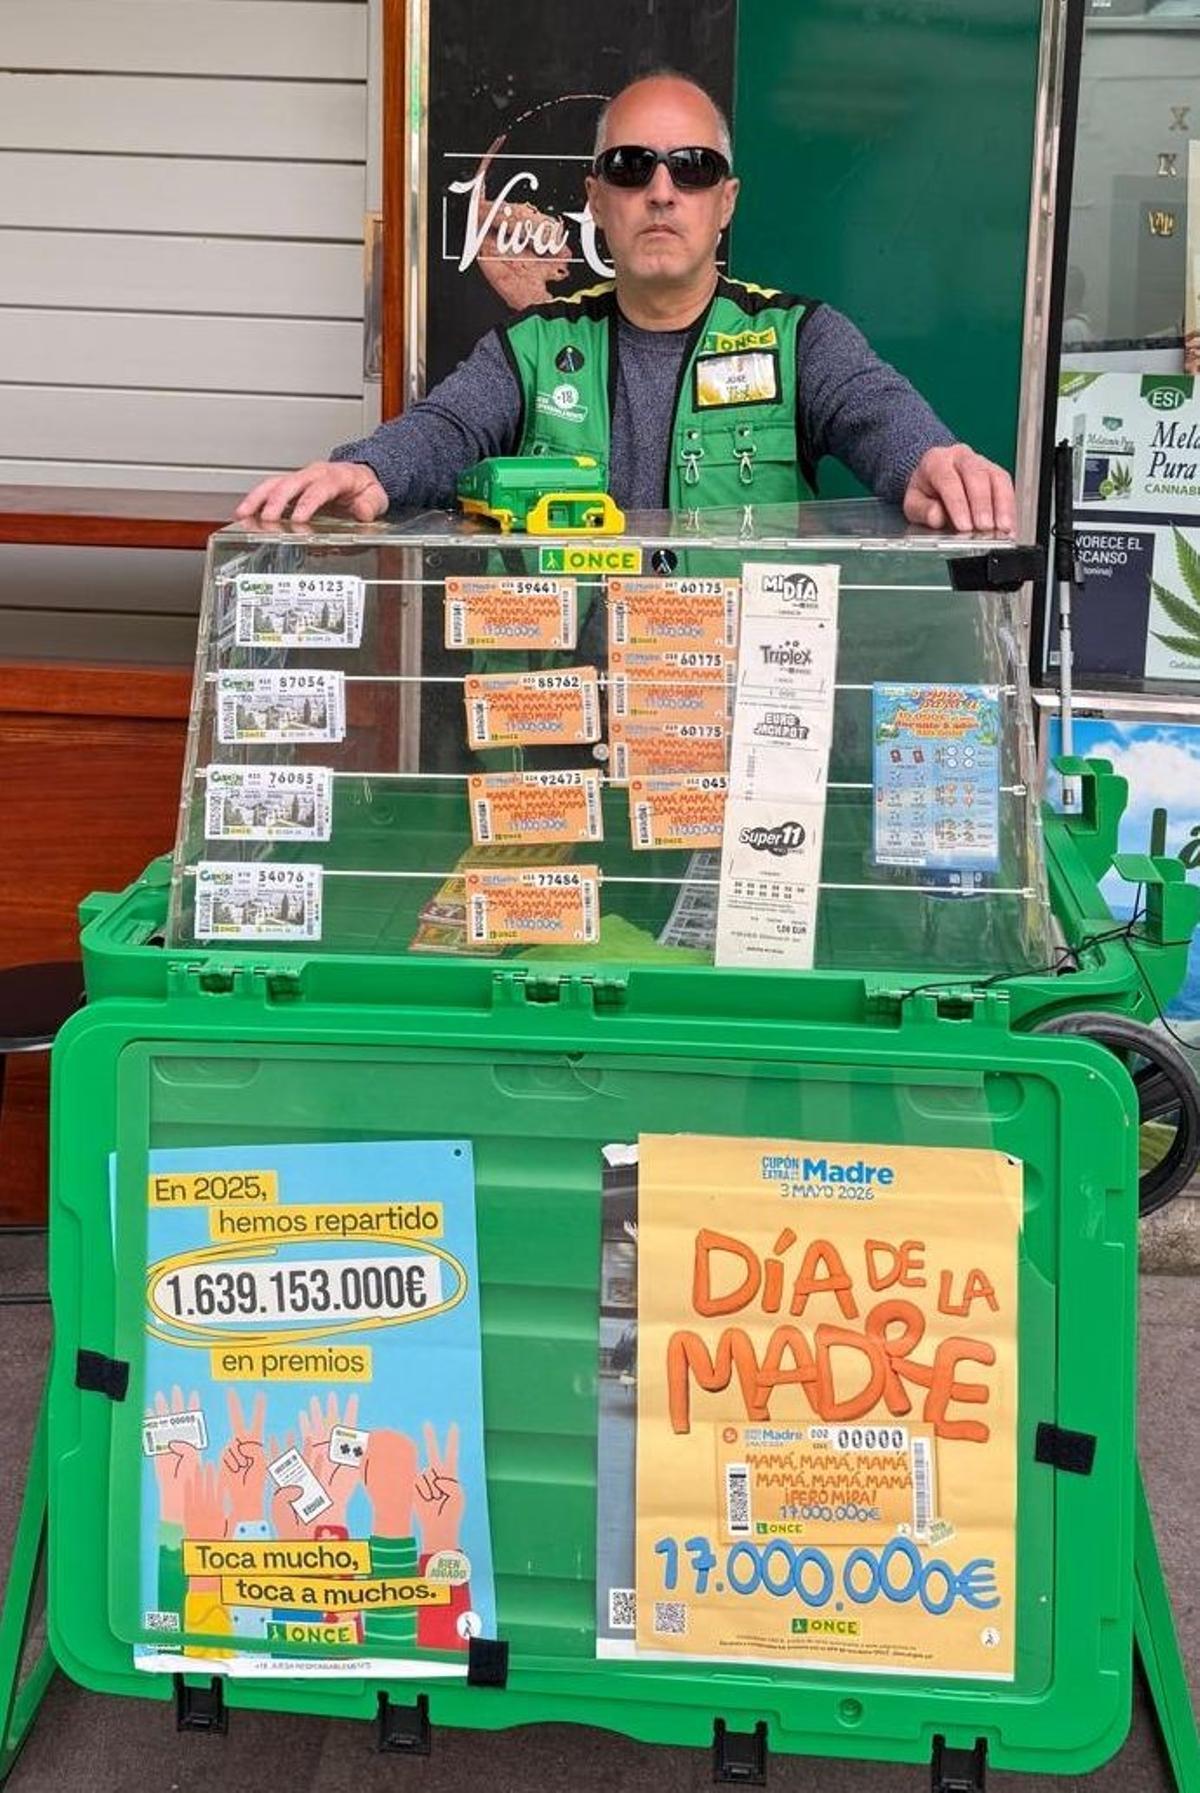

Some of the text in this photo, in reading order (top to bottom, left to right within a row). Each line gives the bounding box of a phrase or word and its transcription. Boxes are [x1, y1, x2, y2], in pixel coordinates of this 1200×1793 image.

[448, 172, 569, 272] Viva
[721, 333, 773, 350] ONCE
[1152, 391, 1179, 407] ESI
[1145, 450, 1197, 479] Pura
[1127, 536, 1143, 550] EL
[569, 553, 635, 569] ONCE
[298, 580, 344, 592] 96123
[517, 582, 557, 594] 59441
[680, 582, 721, 594] 60175
[763, 575, 818, 602] MI DÍA
[680, 653, 721, 666] 60175
[279, 676, 325, 688] 87054
[680, 725, 722, 737] 60175
[540, 773, 582, 786] 92473
[702, 777, 730, 789] 045
[258, 870, 304, 883] 54076
[538, 873, 580, 886] 77484
[762, 1154, 894, 1185] CUPÓN Madre
[155, 1175, 267, 1203] En 2025,
[780, 1184, 875, 1200] 3 MAYO 2026
[219, 1205, 439, 1237] hemos repartido
[692, 1227, 1000, 1320] DÍA DE LA
[166, 1264, 428, 1316] 1.639.153.000€
[222, 1349, 365, 1377] en premios
[666, 1299, 997, 1443] MADRE
[837, 1429, 903, 1449] 00000
[785, 1489, 877, 1506] ¡PERO MIRA!
[779, 1503, 882, 1522] 17.000.000€
[769, 1524, 803, 1534] ONCE
[195, 1545, 360, 1572] Toca mucho,
[654, 1536, 1002, 1616] 17.000.000€
[236, 1578, 437, 1605] toca a muchos.
[291, 1628, 351, 1643] ONCE
[810, 1620, 858, 1635] ONCE
